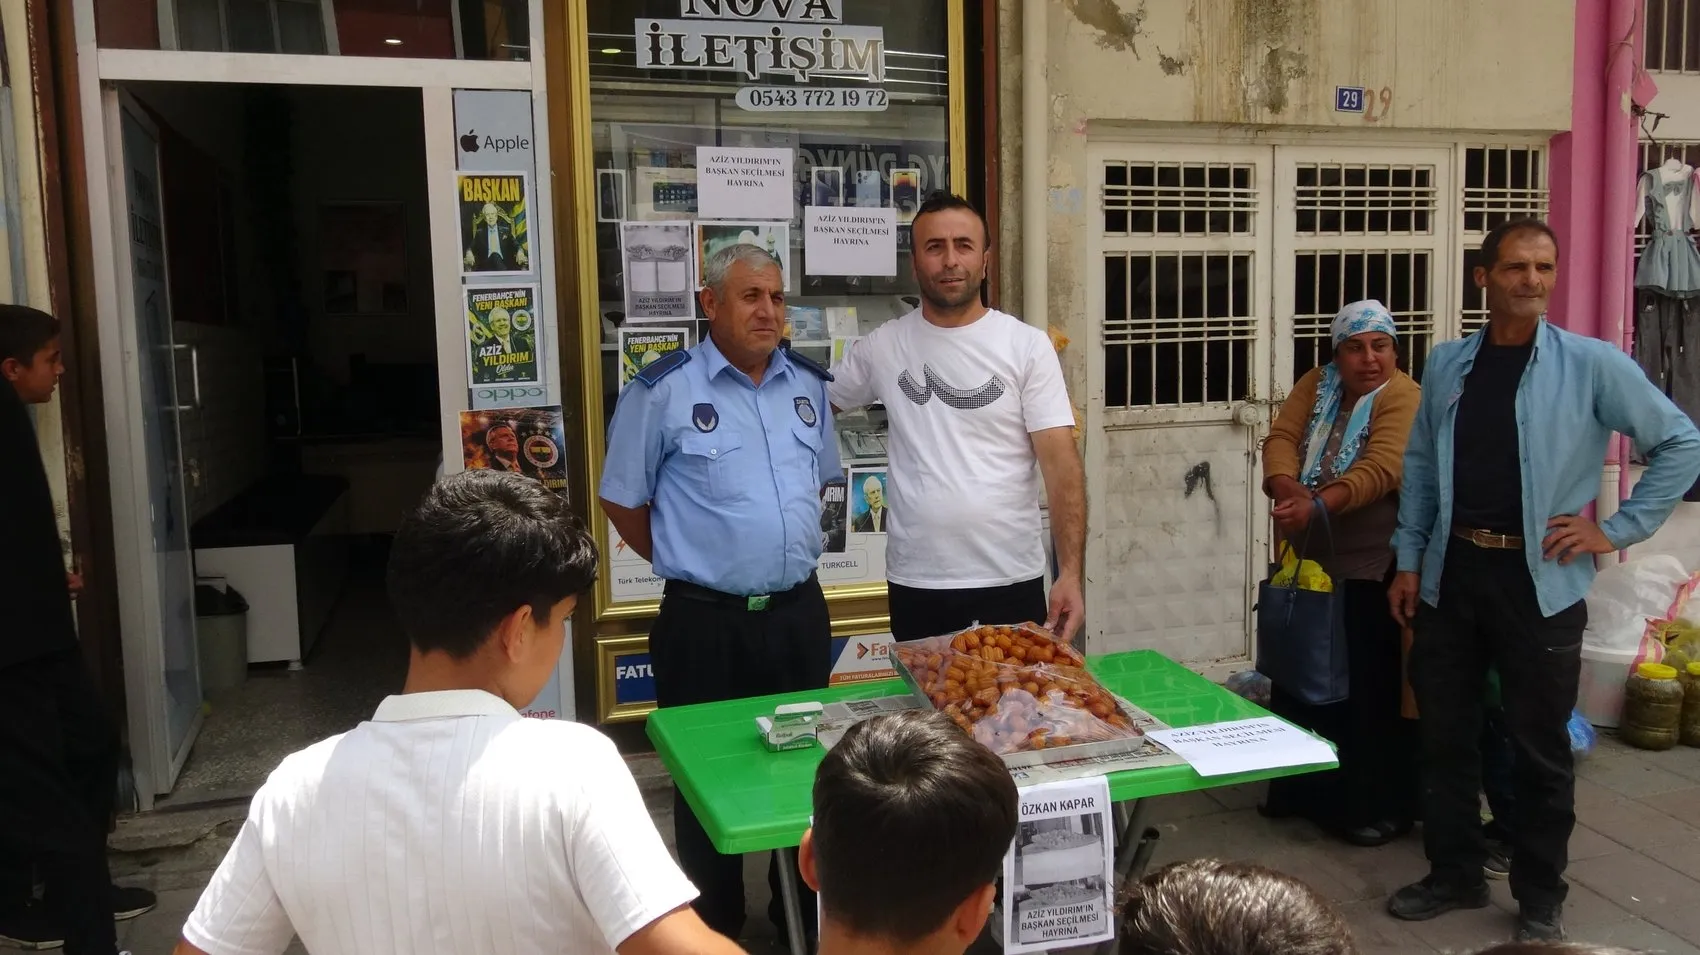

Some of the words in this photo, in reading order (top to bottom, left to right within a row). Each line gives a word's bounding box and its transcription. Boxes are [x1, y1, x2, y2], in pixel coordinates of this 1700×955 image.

[645, 22, 884, 81] İLETİŞİM
[750, 89, 797, 107] 0543
[803, 90, 835, 107] 772
[842, 91, 860, 107] 19
[866, 91, 887, 107] 72
[1343, 91, 1358, 108] 29
[1364, 86, 1392, 123] 29
[483, 135, 529, 153] Apple
[709, 154, 730, 164] AZİZ
[705, 167, 743, 179] BAŞKAN
[747, 167, 785, 178] SEÇİLMESİ
[727, 178, 764, 188] HAYRINA
[817, 213, 838, 224] AZİZ
[813, 225, 846, 237] BAŞKAN
[848, 225, 889, 237] SEÇİLMESİ
[833, 237, 869, 246] HAYRINA
[480, 343, 503, 357] AZİZ
[483, 351, 529, 367] YILDIRIM
[477, 388, 544, 402] oppo
[821, 560, 859, 569] TURKCELL
[618, 577, 633, 585] Türk
[1021, 801, 1057, 816] ÖZKAN
[1060, 797, 1095, 811] KAPAR
[1027, 907, 1046, 920] AZİZ
[1021, 919, 1055, 932] BAŞKAN
[1056, 912, 1099, 927] SEÇİLMESİ
[1042, 926, 1079, 938] HAYRINA
